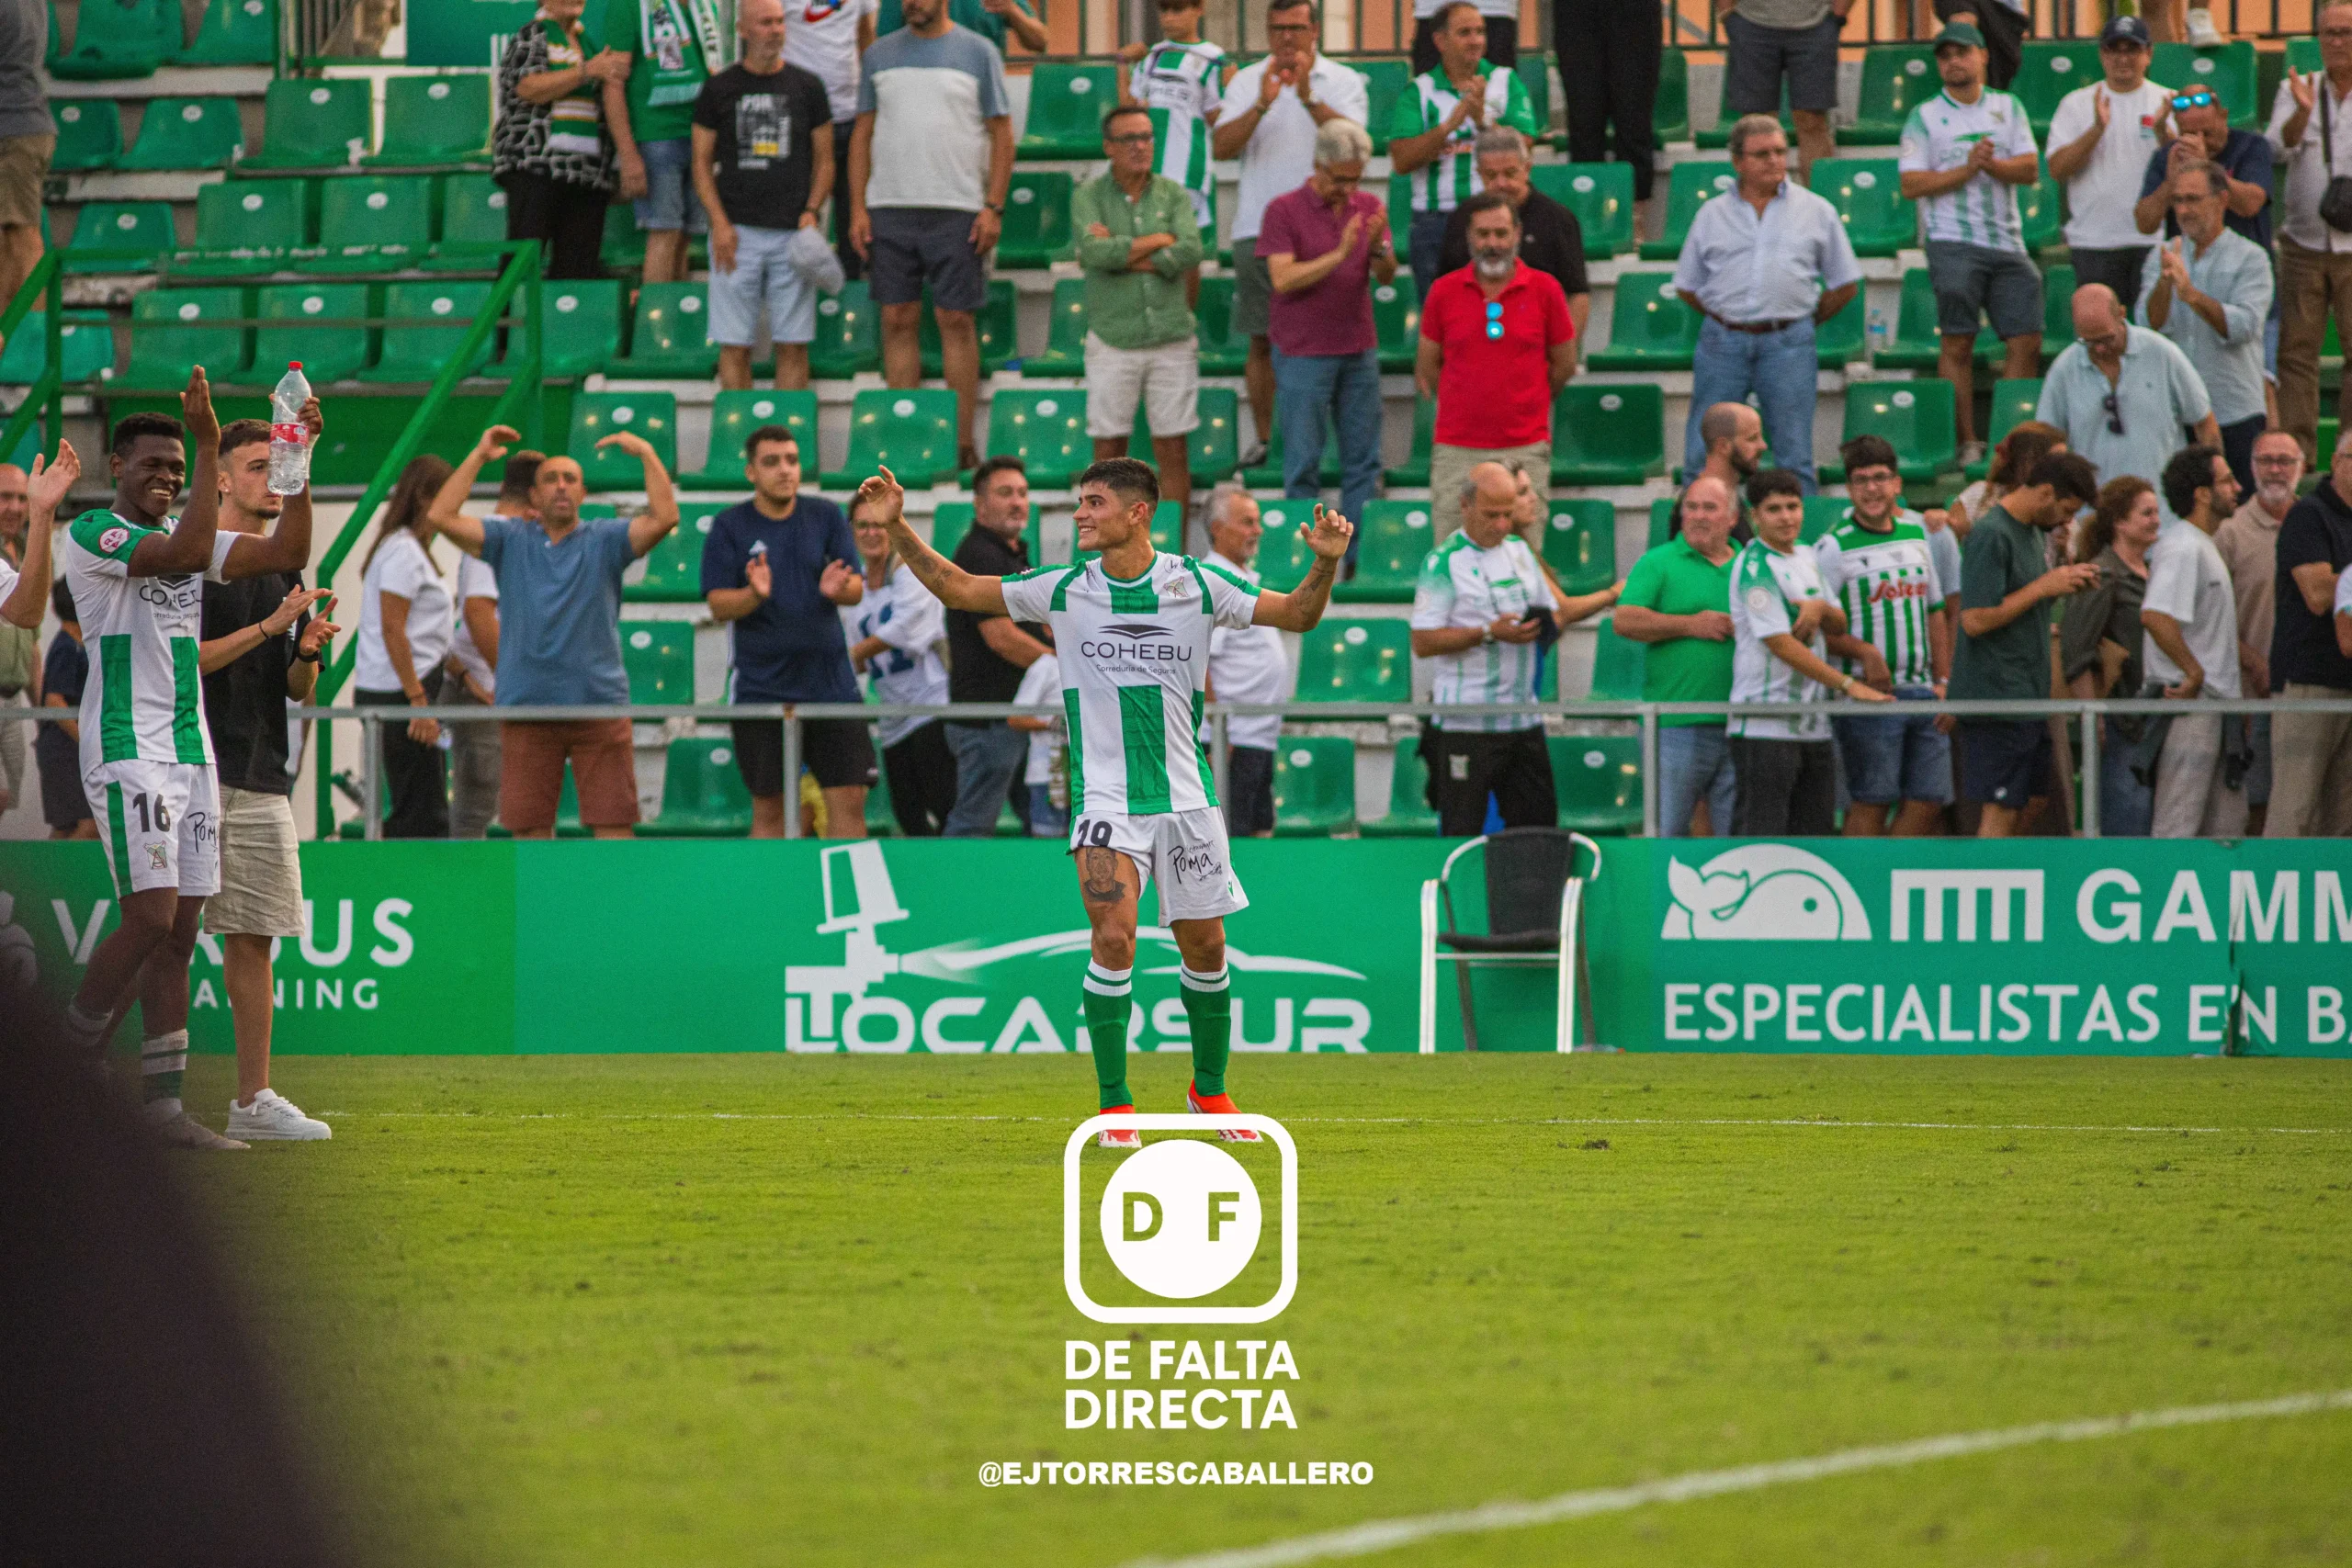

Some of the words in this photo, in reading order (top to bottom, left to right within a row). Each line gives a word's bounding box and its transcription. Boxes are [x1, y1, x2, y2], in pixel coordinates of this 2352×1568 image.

[1080, 640, 1193, 662] COHEBU
[1148, 665, 1177, 676] Seguros
[132, 792, 172, 833] 16
[187, 811, 220, 854] Pom
[1077, 818, 1113, 847] 19
[1167, 845, 1214, 885] Poma
[1664, 983, 2160, 1043] ESPECIALISTAS
[2188, 984, 2277, 1044] EN
[2307, 985, 2352, 1044] B
